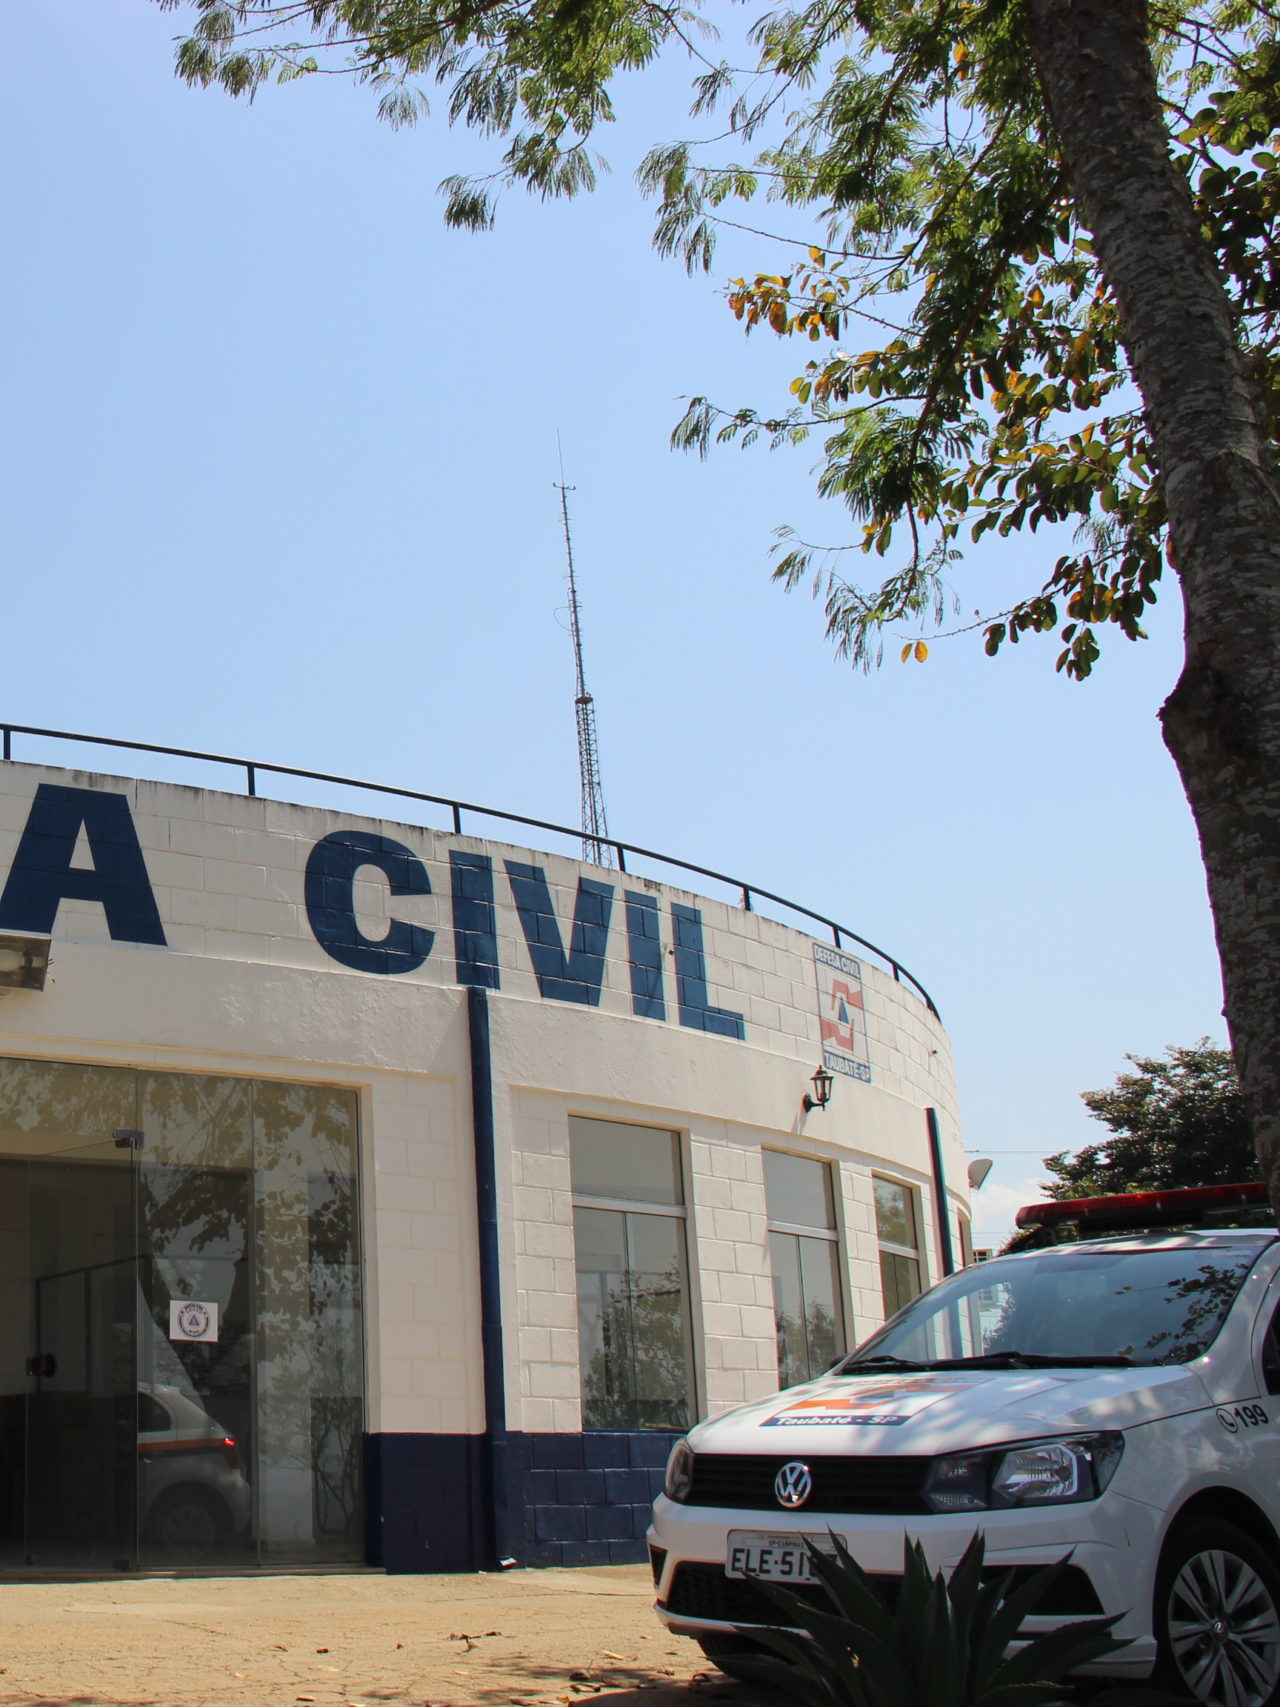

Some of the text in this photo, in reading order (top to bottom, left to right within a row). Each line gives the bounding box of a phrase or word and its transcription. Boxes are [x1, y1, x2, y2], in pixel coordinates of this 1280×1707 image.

[304, 830, 745, 1040] CIVIL
[814, 947, 860, 978] DEFESA CIVIL
[824, 1053, 869, 1081] TAUBATÉ-SP
[775, 1416, 852, 1425] Taubaté
[869, 1416, 898, 1424] SP
[1234, 1404, 1269, 1428] 199
